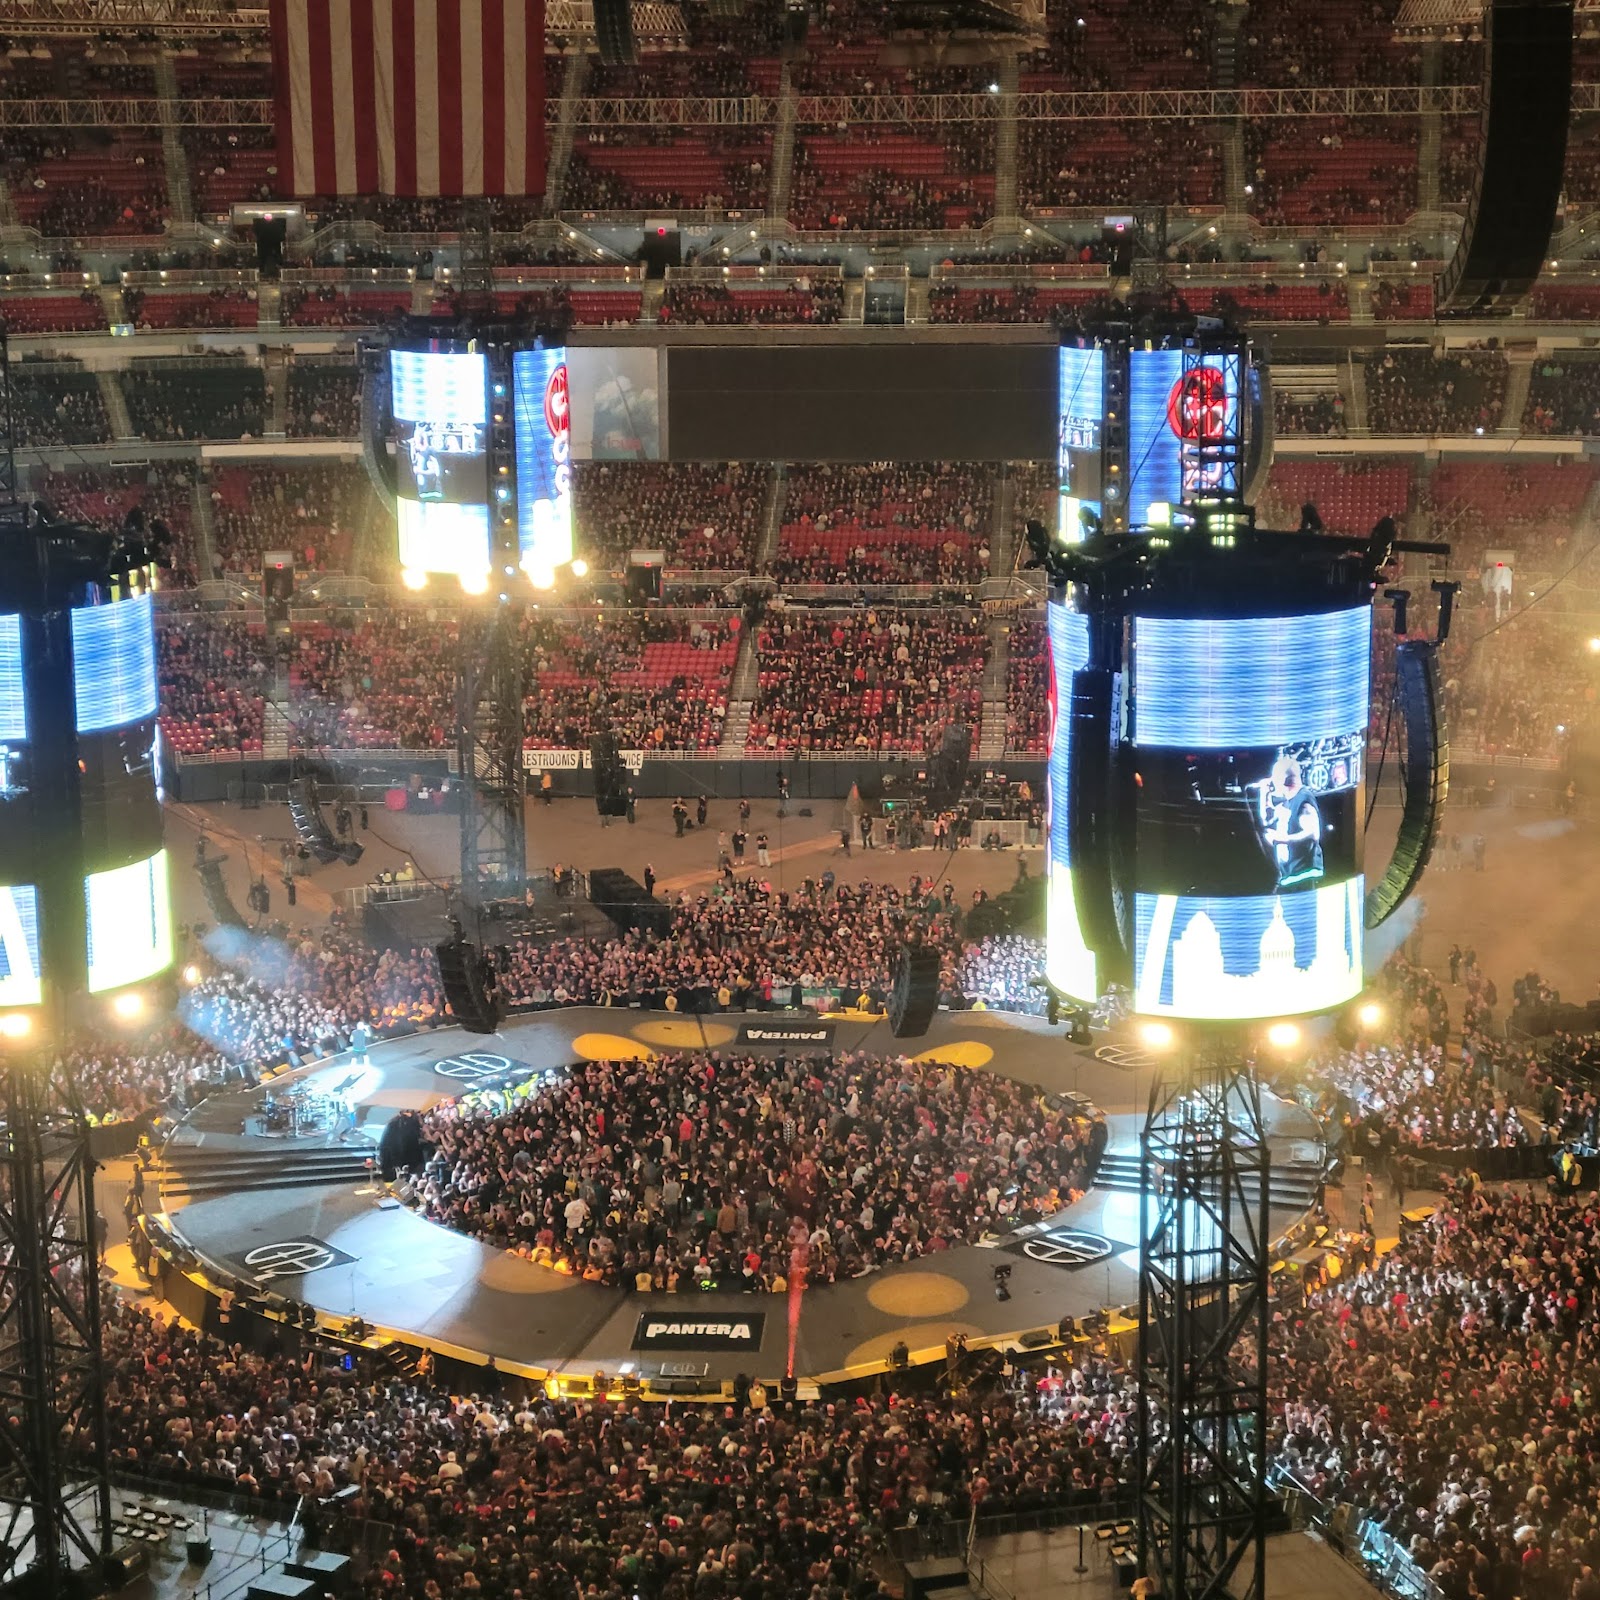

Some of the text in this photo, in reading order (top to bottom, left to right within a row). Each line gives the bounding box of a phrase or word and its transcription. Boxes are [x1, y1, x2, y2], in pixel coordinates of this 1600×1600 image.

[687, 225, 709, 237] 453
[522, 753, 576, 766] RESTROOMS
[619, 753, 641, 766] VICE
[746, 1029, 827, 1040] PANTERA
[645, 1323, 751, 1339] PANTERA
